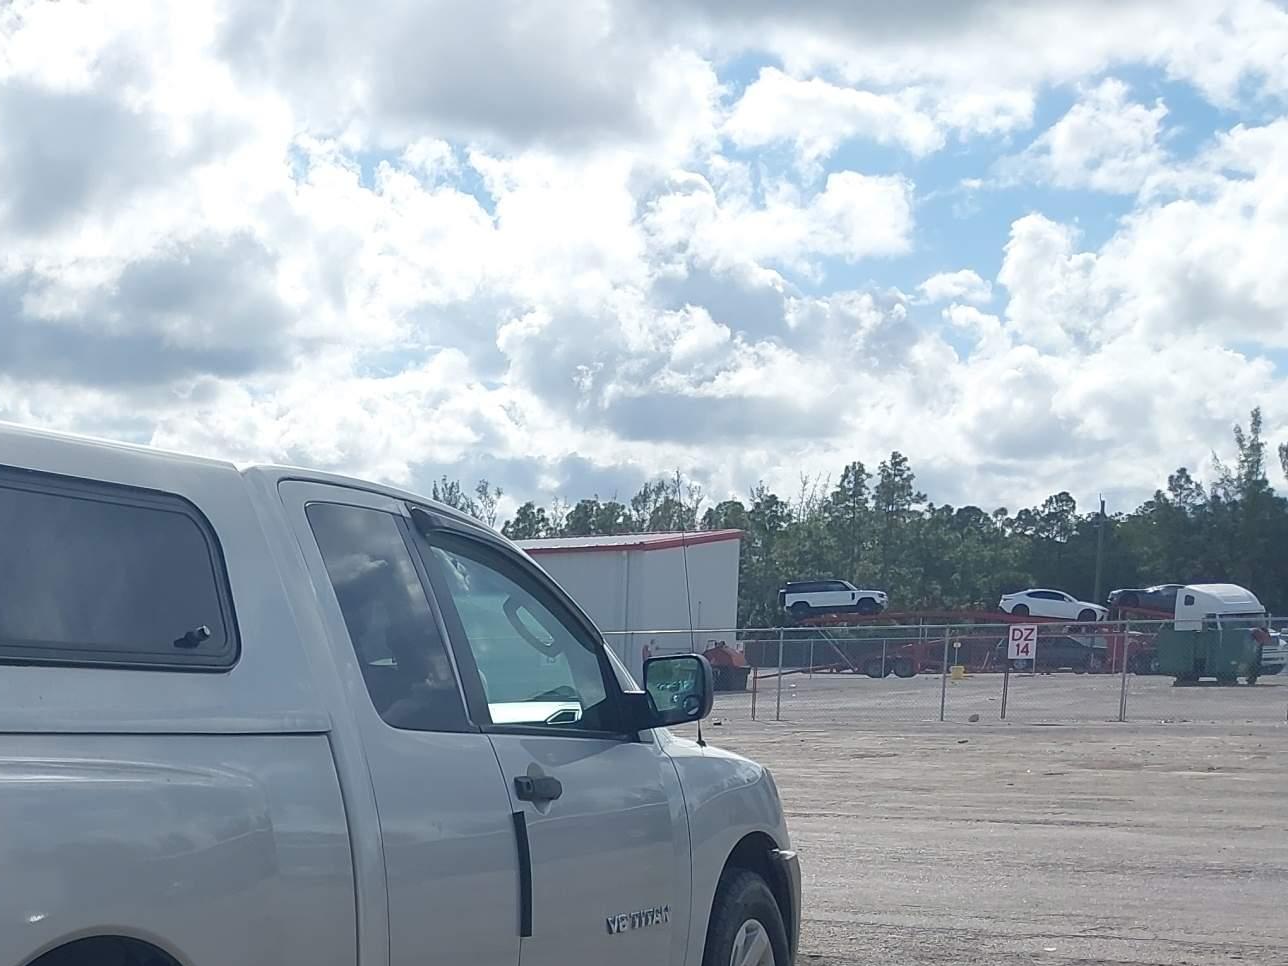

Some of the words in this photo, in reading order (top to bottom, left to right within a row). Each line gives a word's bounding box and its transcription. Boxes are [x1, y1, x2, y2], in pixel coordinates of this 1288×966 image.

[1012, 628, 1035, 641] DZ
[1016, 643, 1030, 656] 14
[631, 904, 671, 928] TITAN
